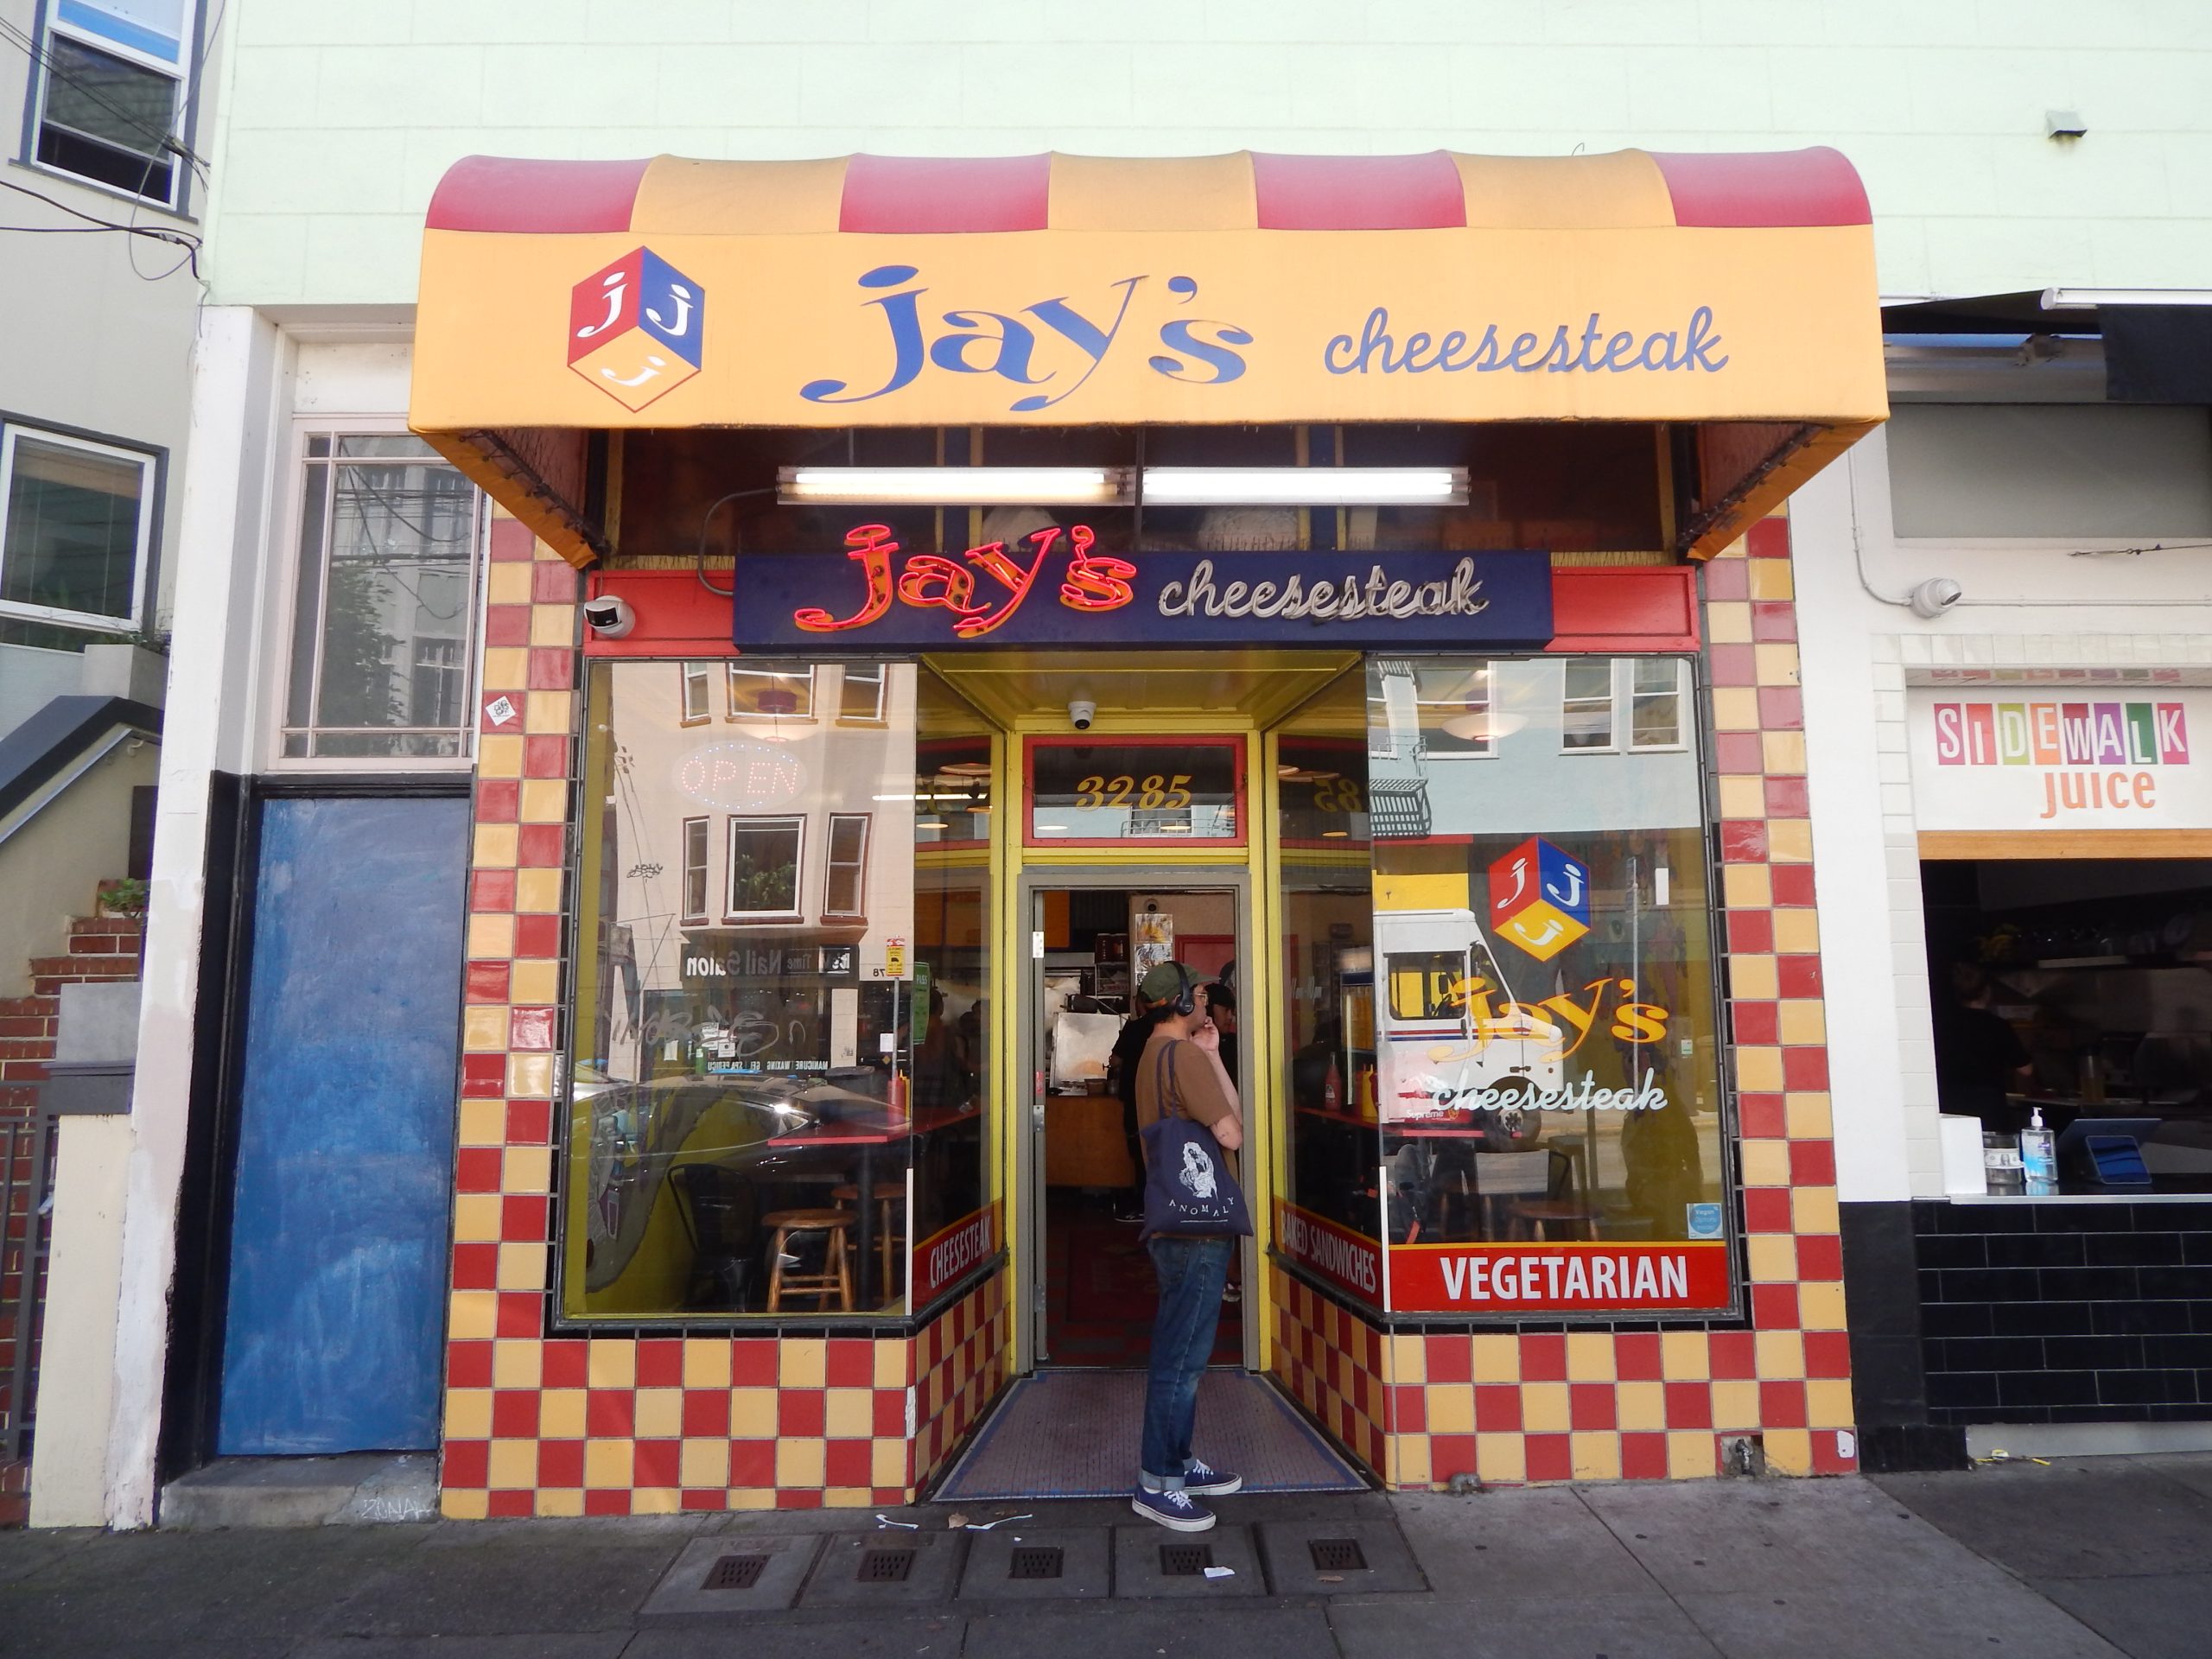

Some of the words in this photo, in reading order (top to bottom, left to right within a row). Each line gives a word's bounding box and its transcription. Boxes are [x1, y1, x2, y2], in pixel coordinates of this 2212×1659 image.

[799, 264, 1254, 412] jay's
[1325, 307, 1729, 375] cheesesteak
[794, 524, 1137, 638] jay's
[1159, 556, 1490, 624] cheesesteak
[1937, 706, 2186, 765] SIDEWALK
[681, 755, 798, 795] OPEN
[1075, 774, 1192, 811] 3285
[1427, 976, 1669, 1065] jay's
[1406, 1109, 1444, 1120] Supreme
[1430, 1066, 1668, 1111] cheesesteak
[1168, 1197, 1235, 1217] ANOMALY
[930, 1215, 991, 1289] CHEESESTEAK
[1280, 1209, 1309, 1256] BAKED
[1310, 1224, 1376, 1294] SANDWICHES
[1440, 1255, 1688, 1300] VEGETARIAN
